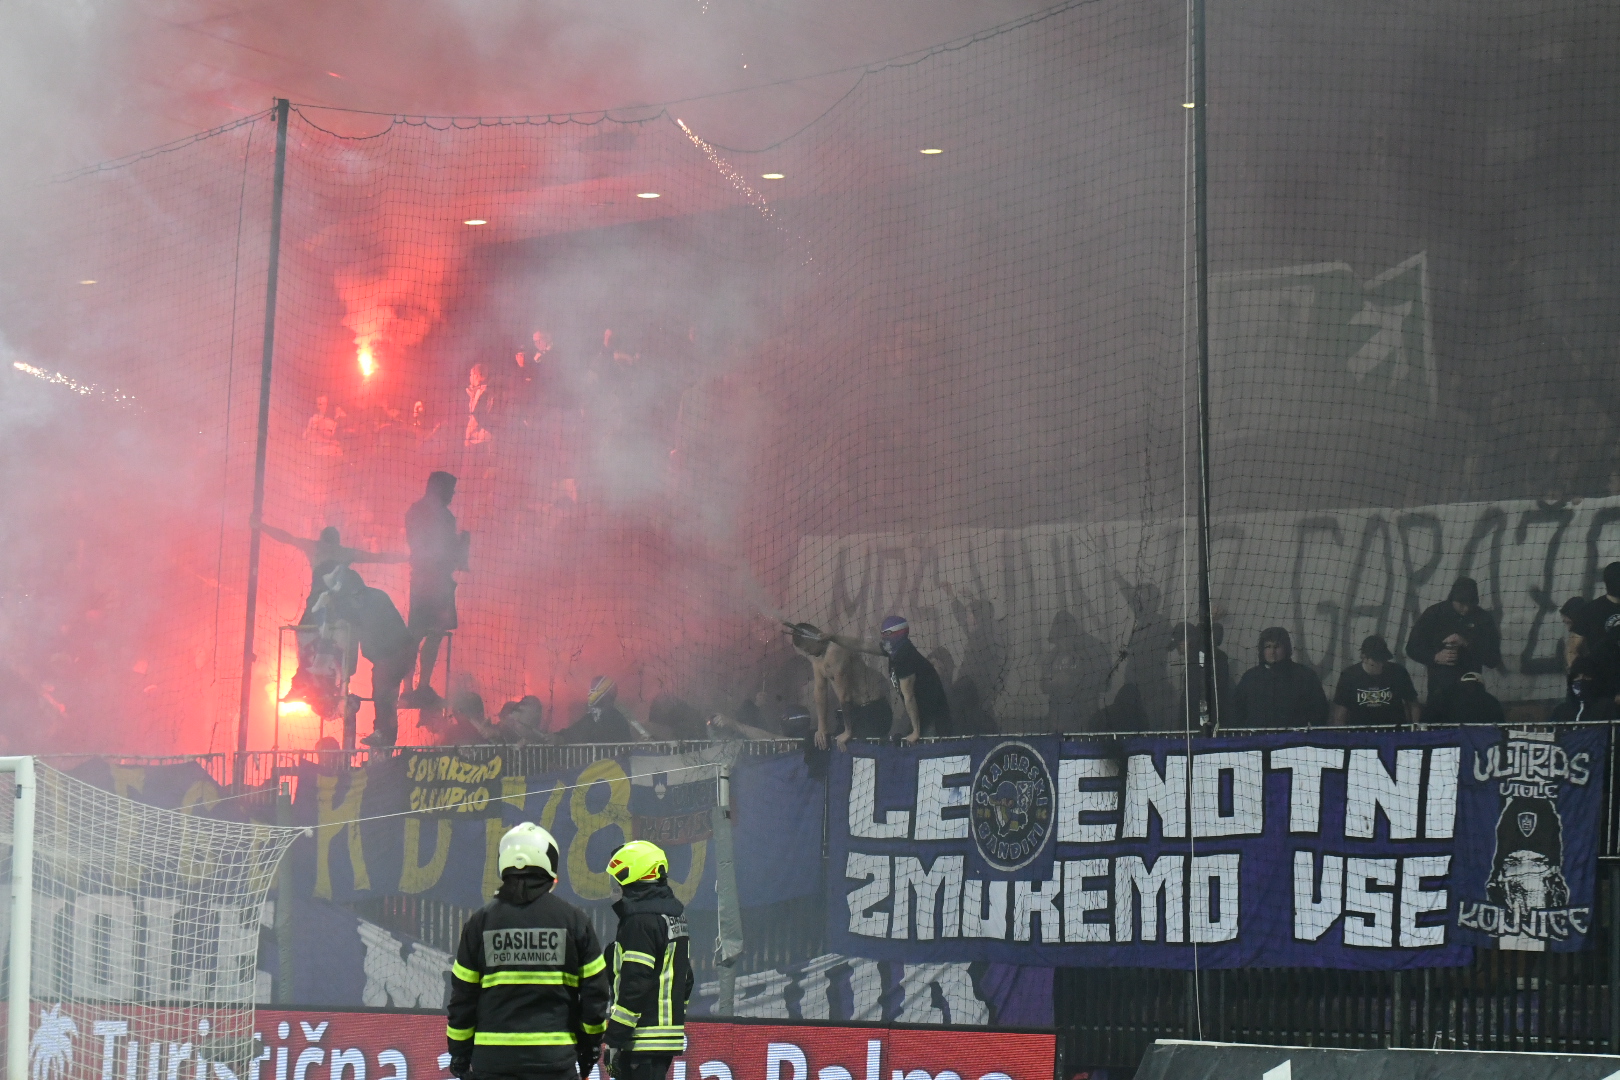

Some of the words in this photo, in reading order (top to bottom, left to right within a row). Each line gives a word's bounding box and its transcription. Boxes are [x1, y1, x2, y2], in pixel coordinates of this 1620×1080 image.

[1473, 741, 1590, 786] ULTRAS
[1057, 746, 1460, 842] ENOTNI
[492, 931, 559, 951] GASILEC
[493, 952, 511, 963] PGD
[513, 952, 558, 962] KAMNICA
